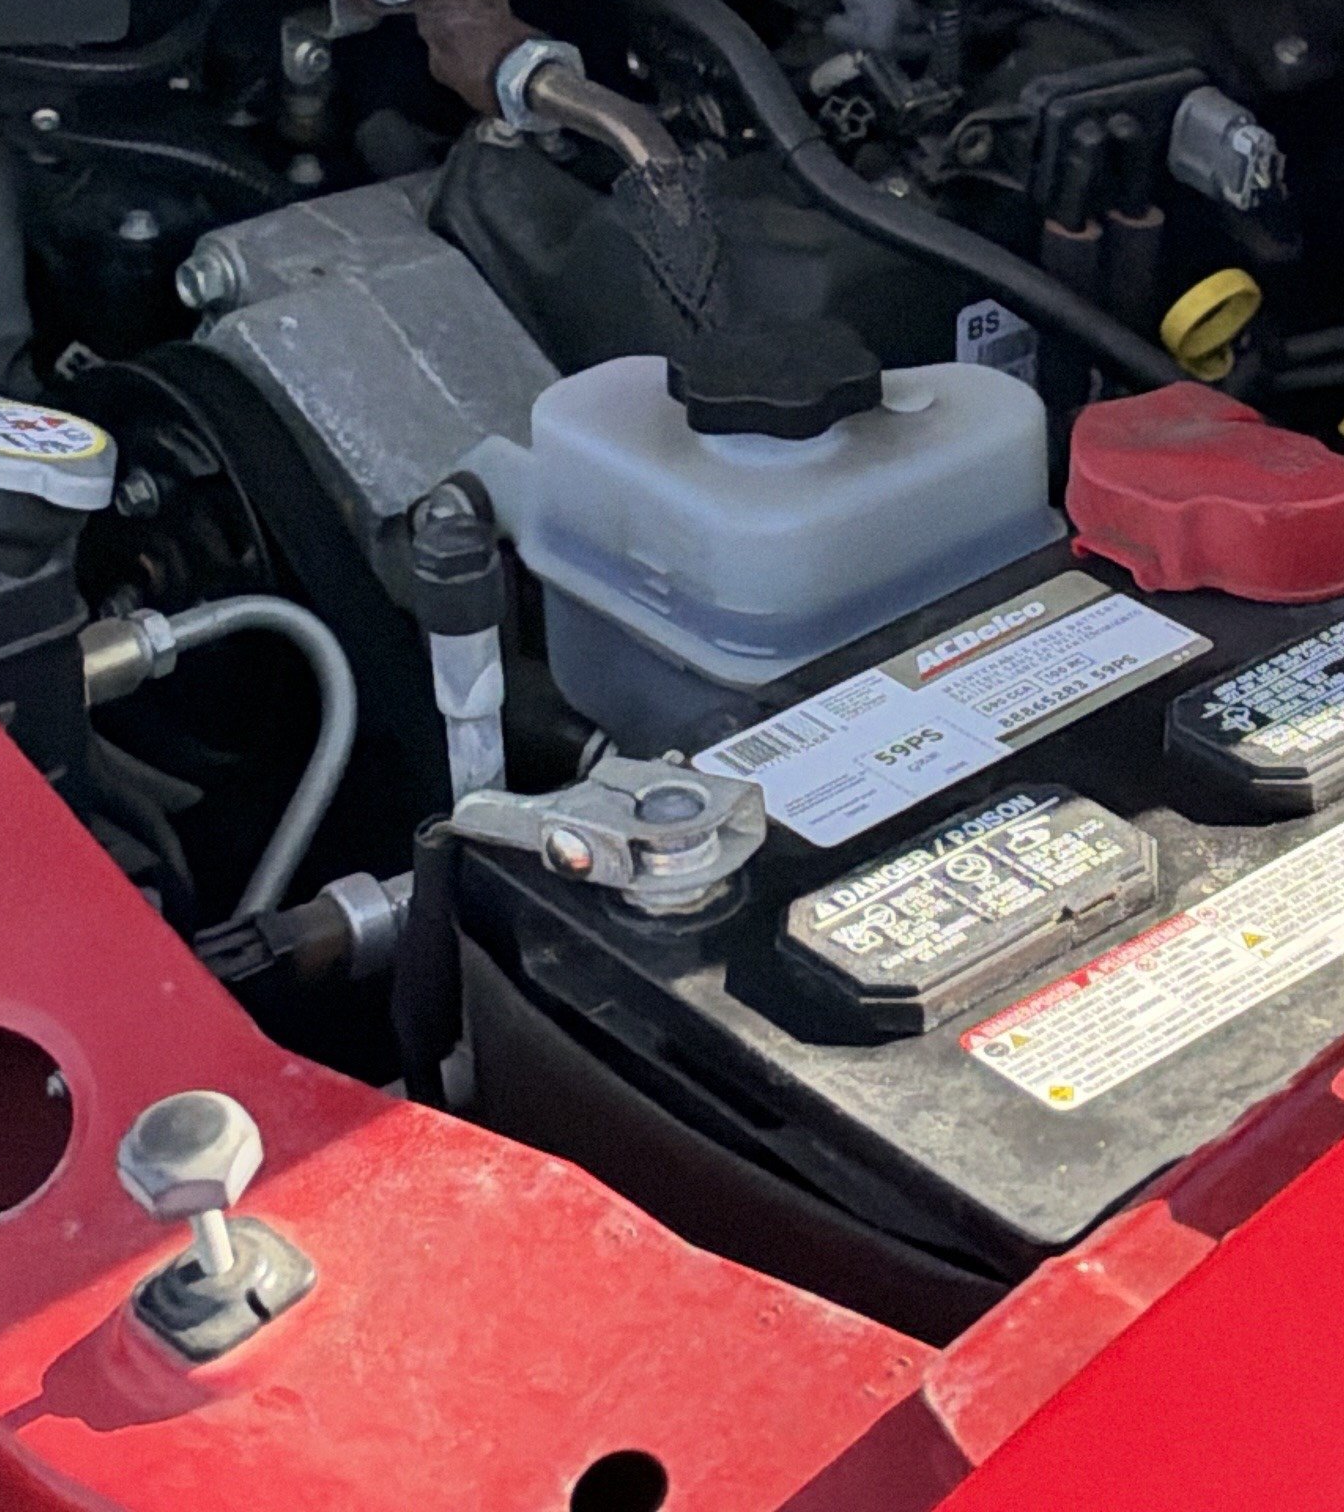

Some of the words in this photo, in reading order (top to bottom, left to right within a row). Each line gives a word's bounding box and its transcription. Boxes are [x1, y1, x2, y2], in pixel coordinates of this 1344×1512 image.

[915, 600, 1046, 674] ACDelco
[1090, 654, 1139, 680] 59PS
[875, 728, 945, 767] 59PS
[832, 848, 934, 906] DANGER
[947, 794, 1037, 846] POISON
